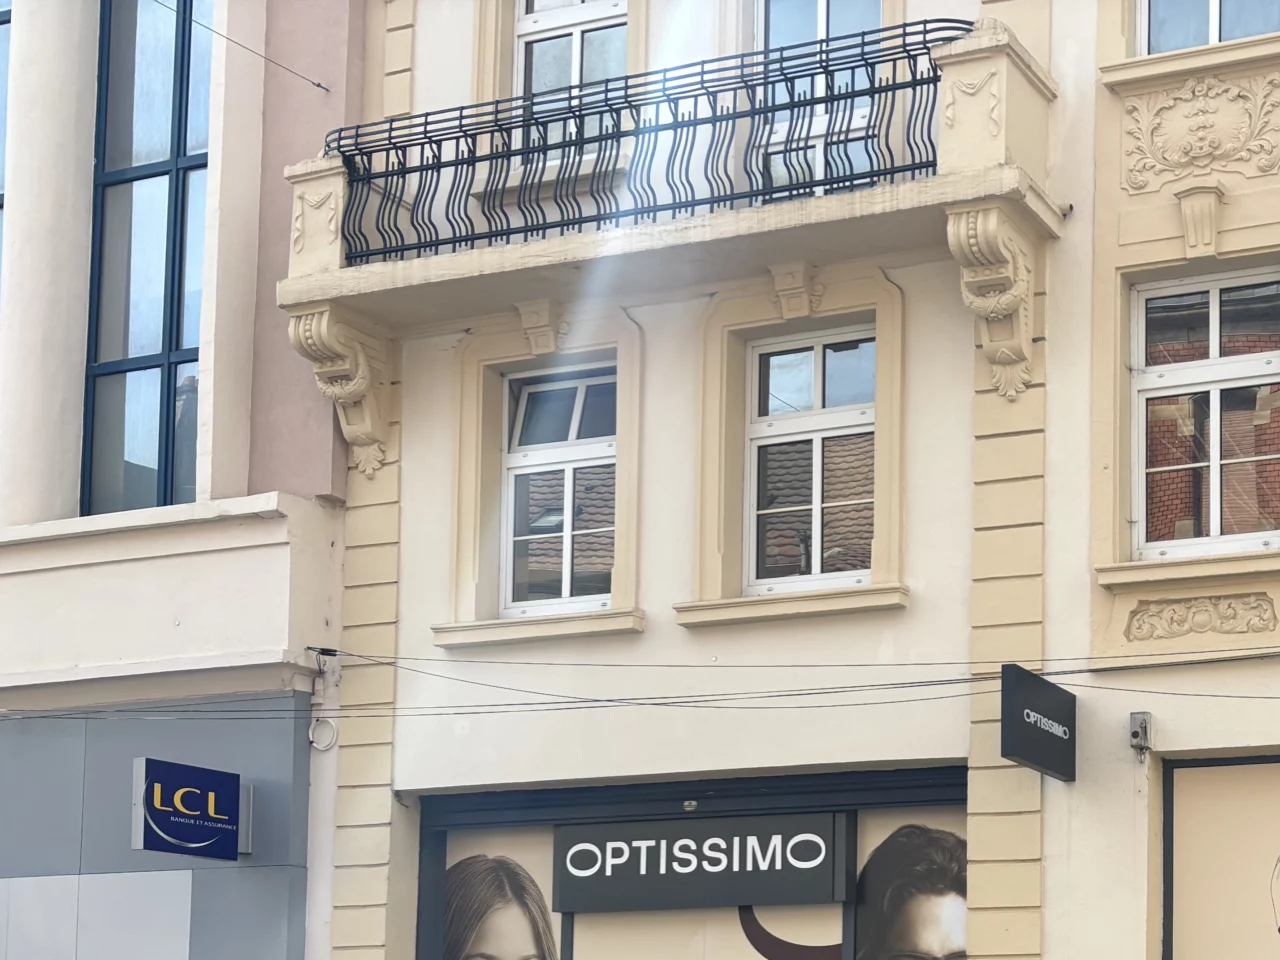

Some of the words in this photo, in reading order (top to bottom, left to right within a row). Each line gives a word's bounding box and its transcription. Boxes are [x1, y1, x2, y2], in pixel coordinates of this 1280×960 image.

[1024, 709, 1070, 740] OPTISSIMO
[153, 783, 229, 819] LCL
[170, 816, 195, 825] BANQUE
[204, 821, 237, 831] ASSURANCE
[566, 833, 826, 877] OPTISSIMO
